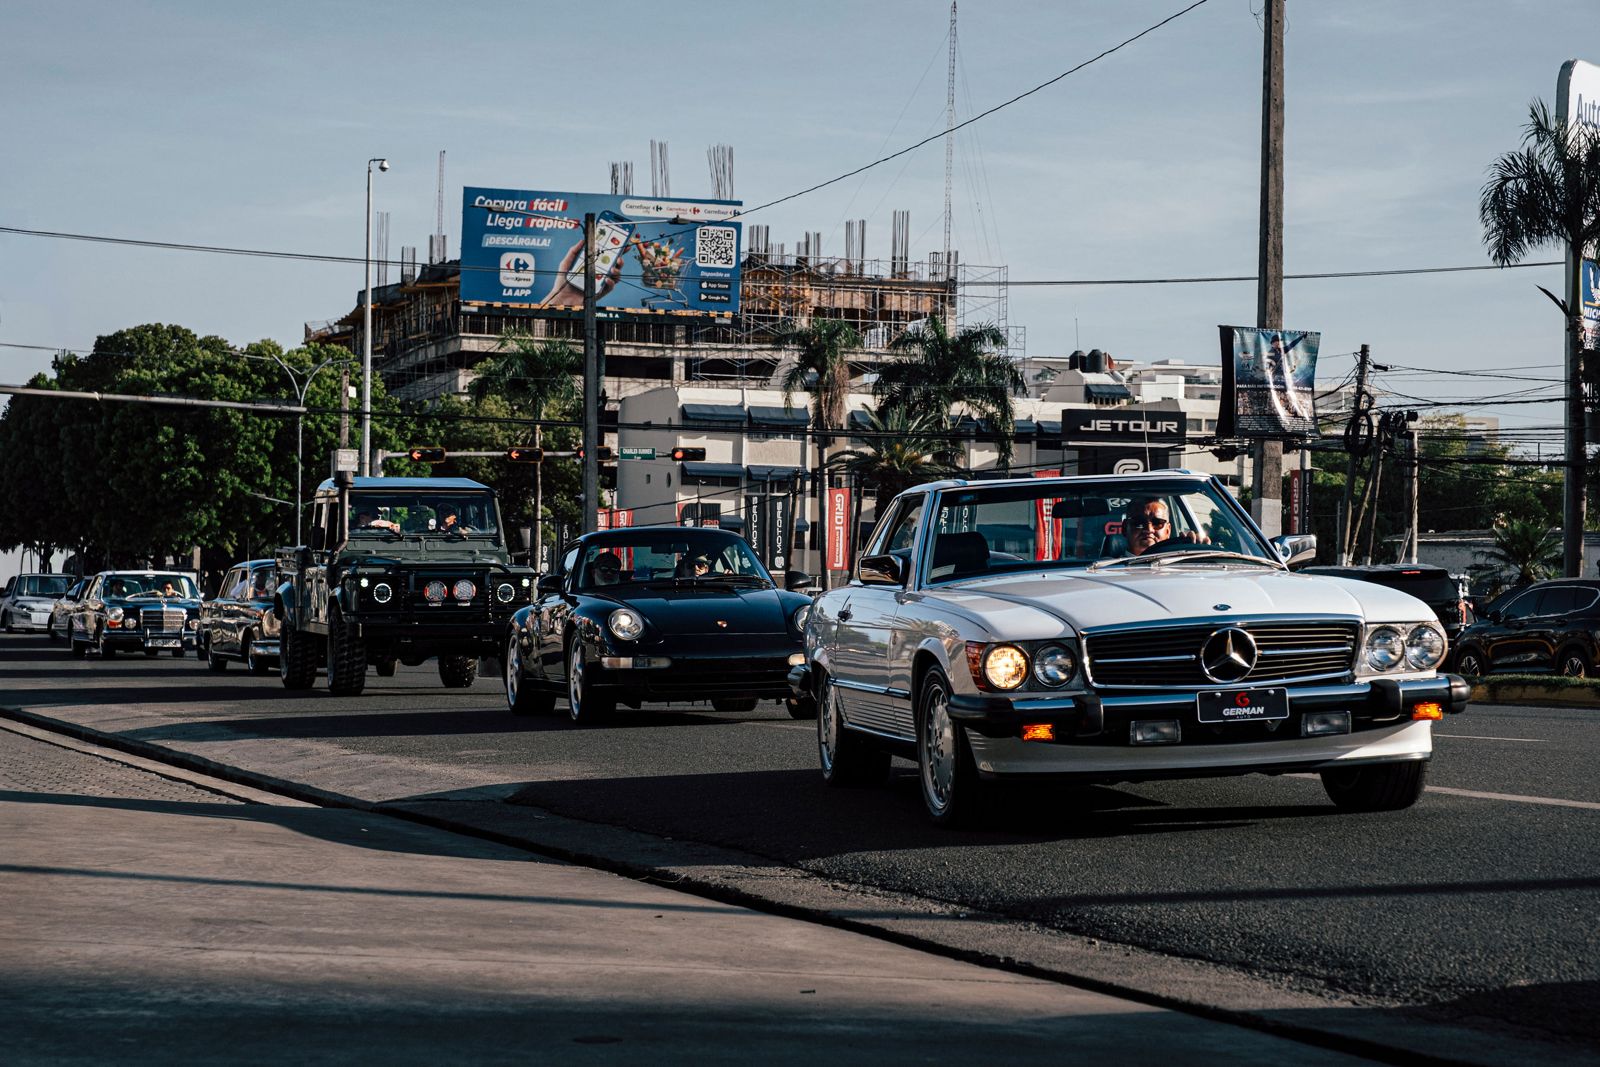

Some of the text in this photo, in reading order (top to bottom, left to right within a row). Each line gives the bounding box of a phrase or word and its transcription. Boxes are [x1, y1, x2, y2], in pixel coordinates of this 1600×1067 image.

[475, 195, 564, 212] Compra fácil
[486, 213, 523, 230] Llega
[485, 235, 551, 248] ¡DESCÁRGALA!
[502, 288, 532, 297] LA APP
[1080, 419, 1178, 433] JETOUR
[835, 493, 845, 525] GRID
[1223, 706, 1264, 716] GERMAN
